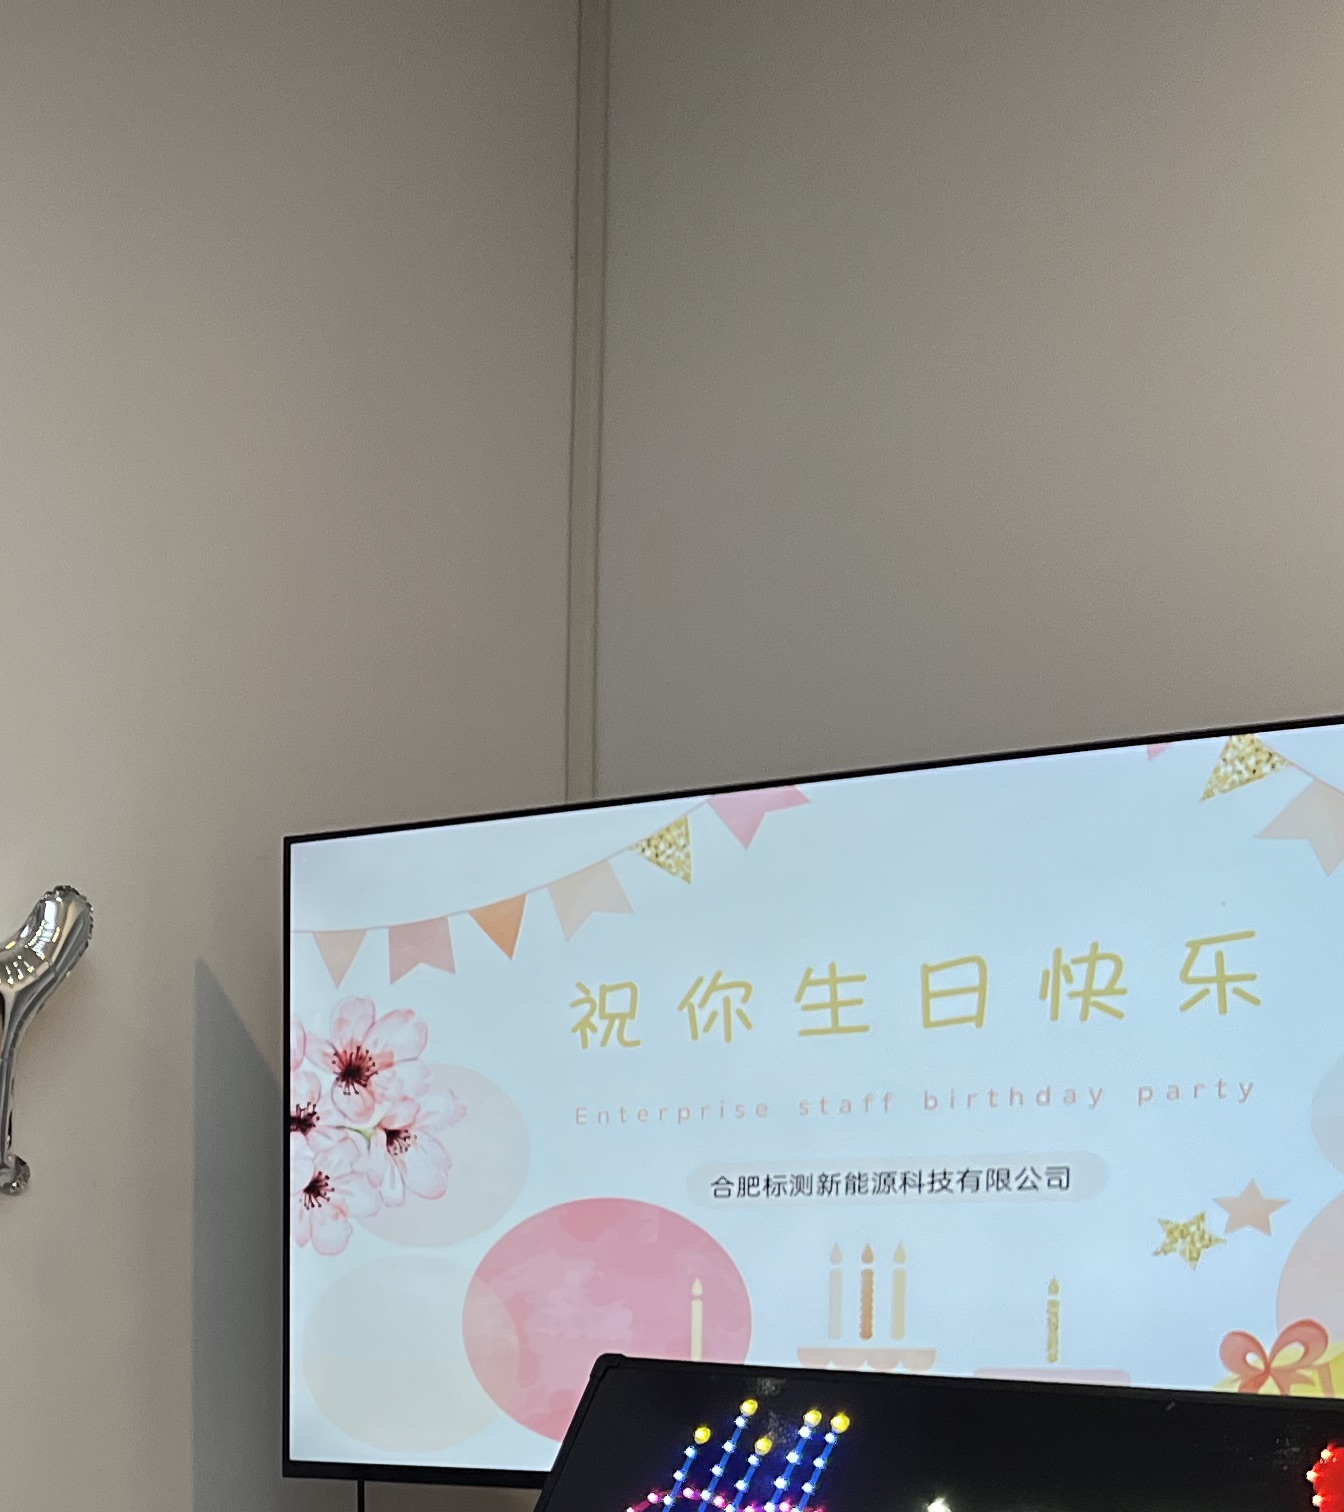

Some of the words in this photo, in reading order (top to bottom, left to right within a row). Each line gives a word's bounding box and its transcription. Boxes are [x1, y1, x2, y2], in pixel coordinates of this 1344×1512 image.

[569, 930, 1262, 1050] 祝你生日快乐
[574, 1100, 770, 1126] Enterprise
[798, 1090, 896, 1118] staff
[923, 1083, 1108, 1115] birthday
[1137, 1077, 1258, 1110] party
[710, 1166, 1072, 1201] 合肥标测新能源科技有限公司
